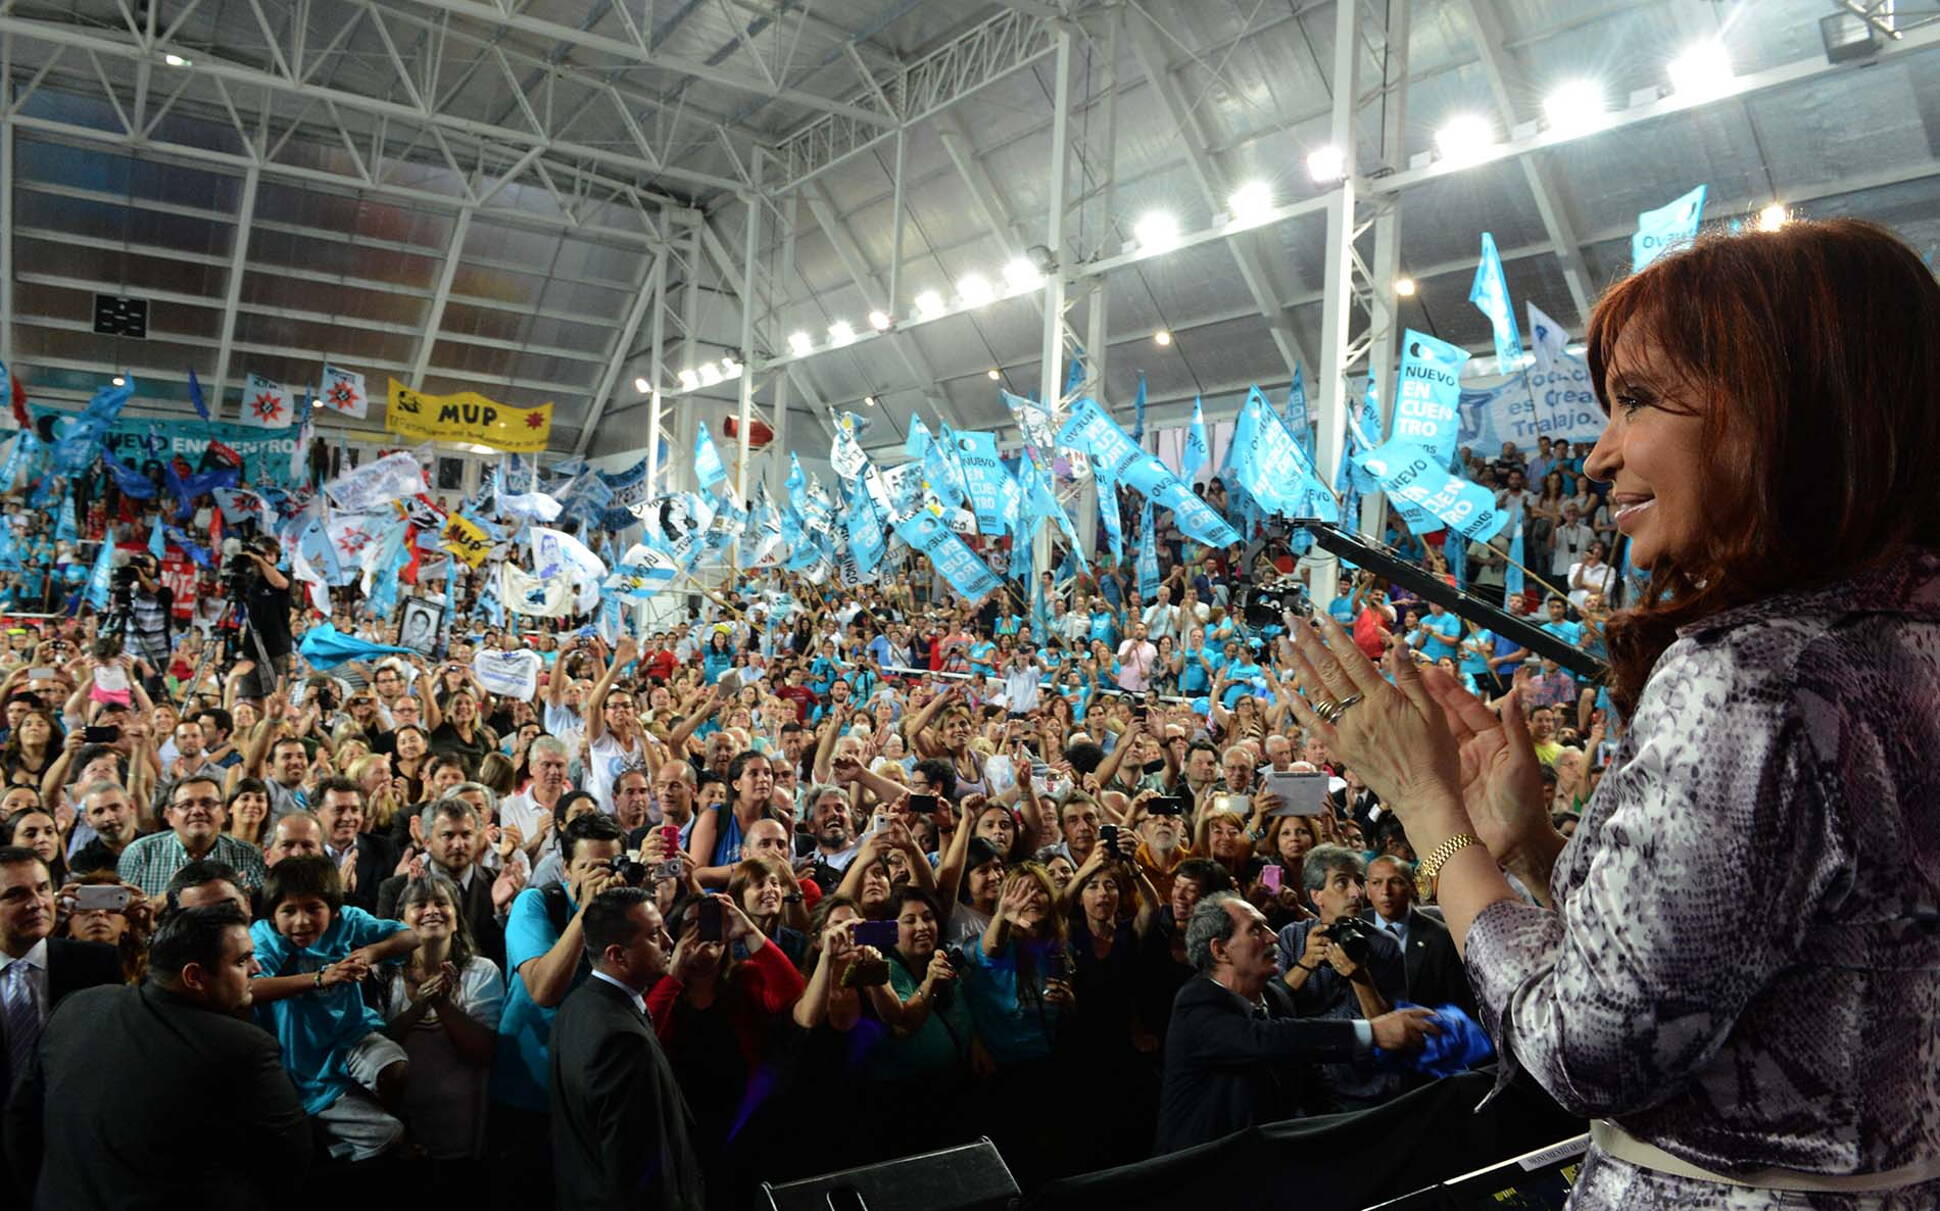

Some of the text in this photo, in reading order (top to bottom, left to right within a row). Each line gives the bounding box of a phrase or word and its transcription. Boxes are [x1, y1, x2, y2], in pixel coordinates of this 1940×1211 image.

[1406, 366, 1455, 386] NUEVO
[1403, 380, 1430, 399] EN
[1400, 400, 1454, 421] CUEN
[1509, 390, 1597, 415] es Crea
[437, 403, 497, 427] MUP
[1363, 405, 1381, 429] EVO
[1399, 417, 1437, 437] TRO
